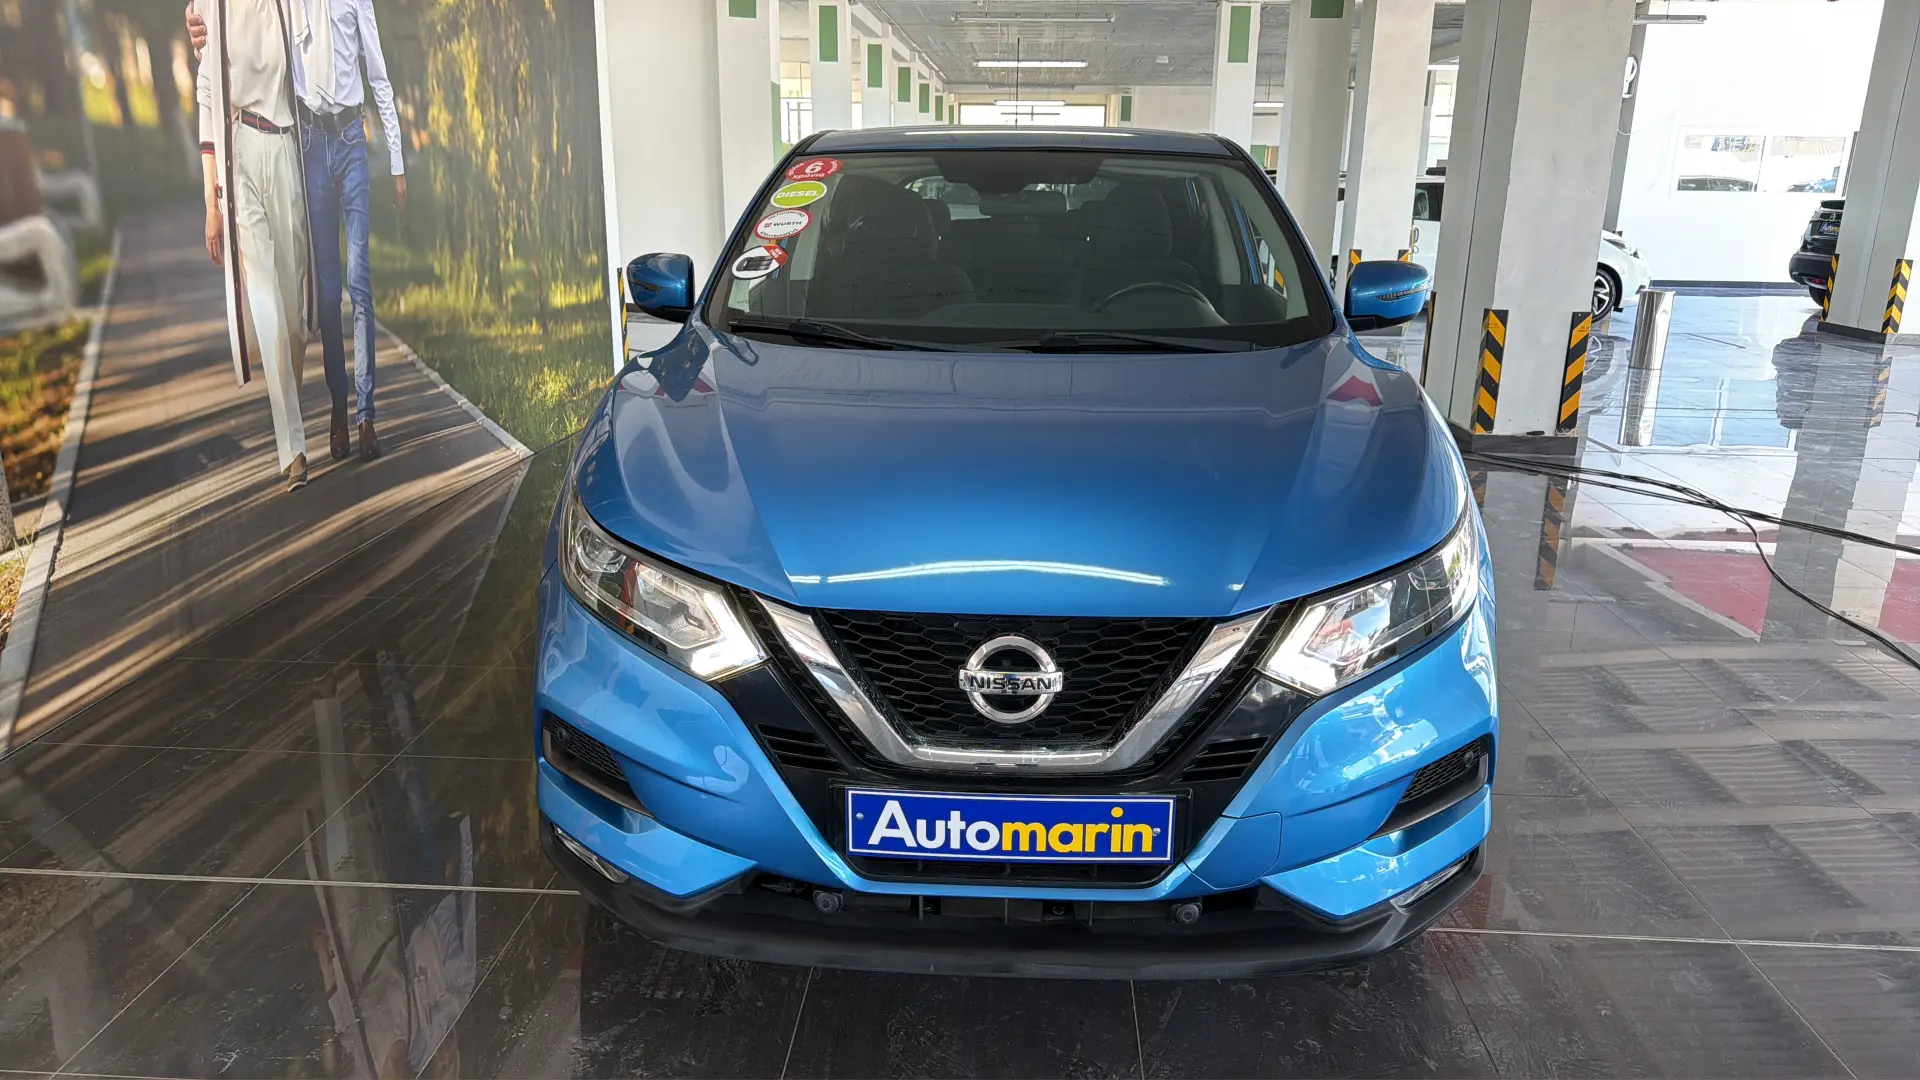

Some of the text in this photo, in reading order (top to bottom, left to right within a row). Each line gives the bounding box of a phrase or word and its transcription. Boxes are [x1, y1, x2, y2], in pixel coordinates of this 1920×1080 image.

[805, 160, 824, 173] 6
[775, 190, 820, 198] DIESEL
[969, 675, 1052, 691] NISSAN
[867, 799, 1153, 853] Automarin
